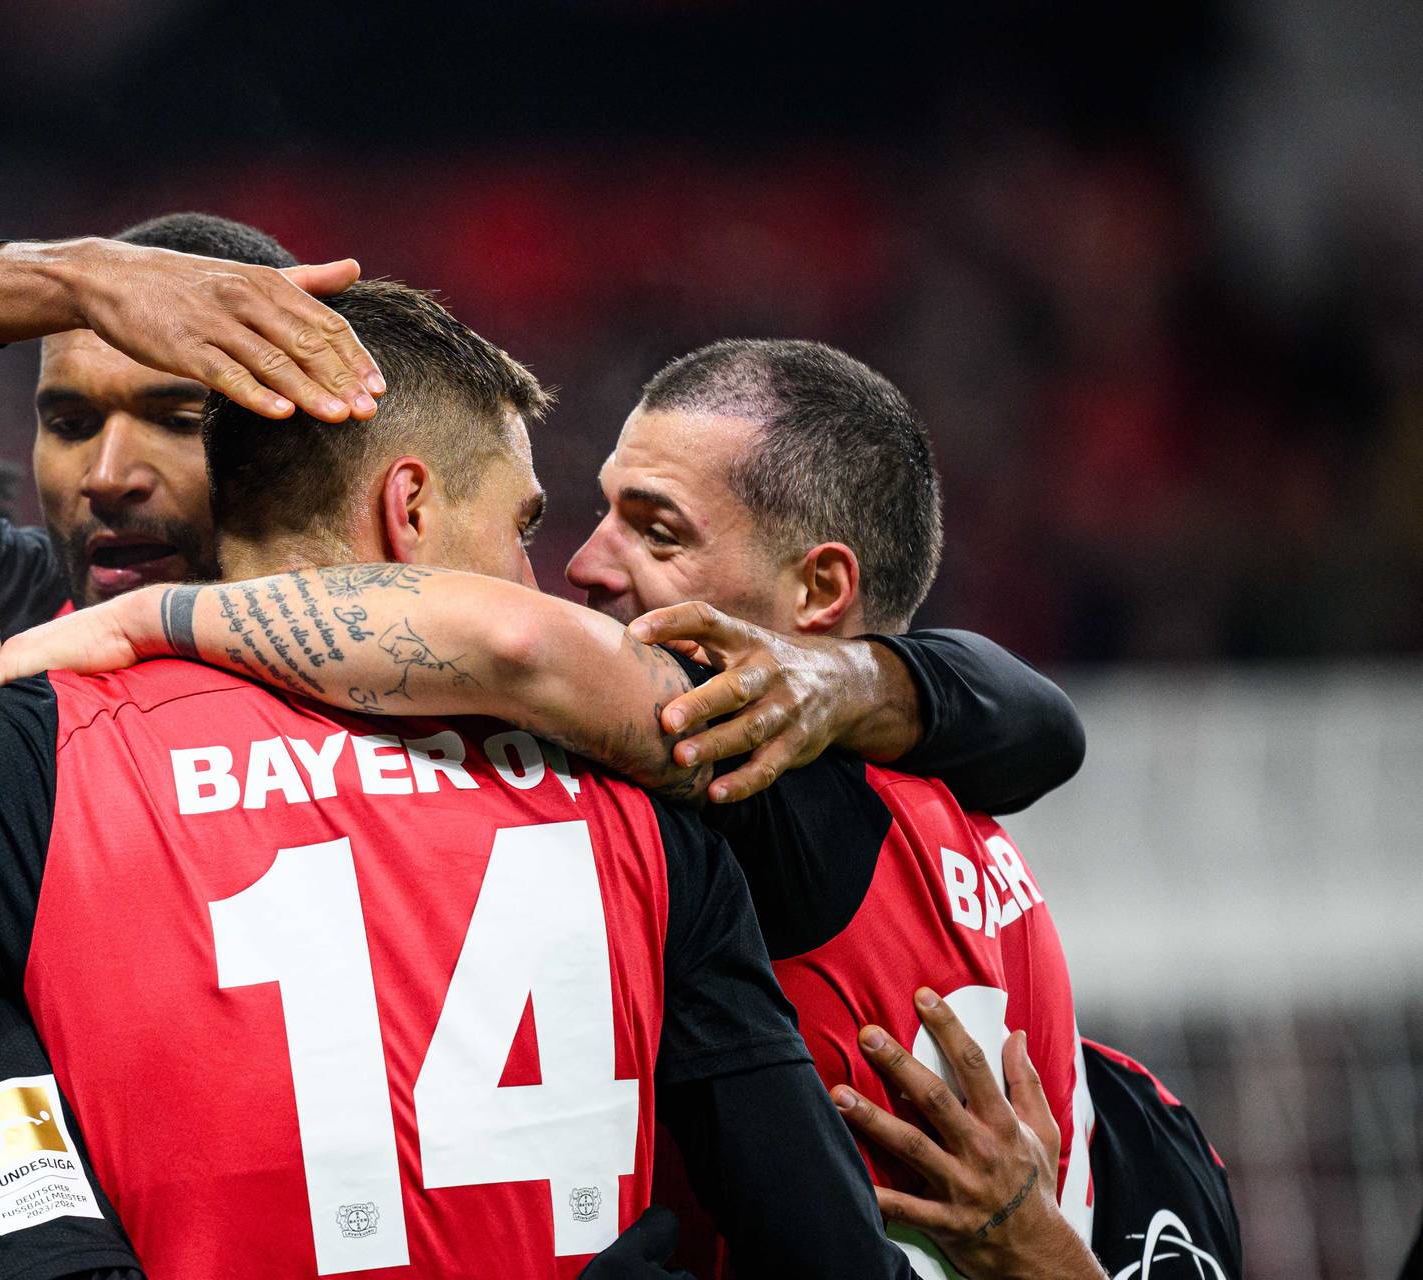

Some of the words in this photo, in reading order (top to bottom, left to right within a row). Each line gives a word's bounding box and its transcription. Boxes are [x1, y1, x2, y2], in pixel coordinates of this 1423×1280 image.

[333, 604, 375, 642] Bob
[169, 730, 481, 817] BAYER
[939, 835, 1045, 939] BAR
[208, 819, 640, 1276] 14
[1, 1191, 88, 1219] FUSSBALLMEISTER
[15, 1183, 71, 1206] DEUTSCHER
[27, 1200, 76, 1219] 2023/2024
